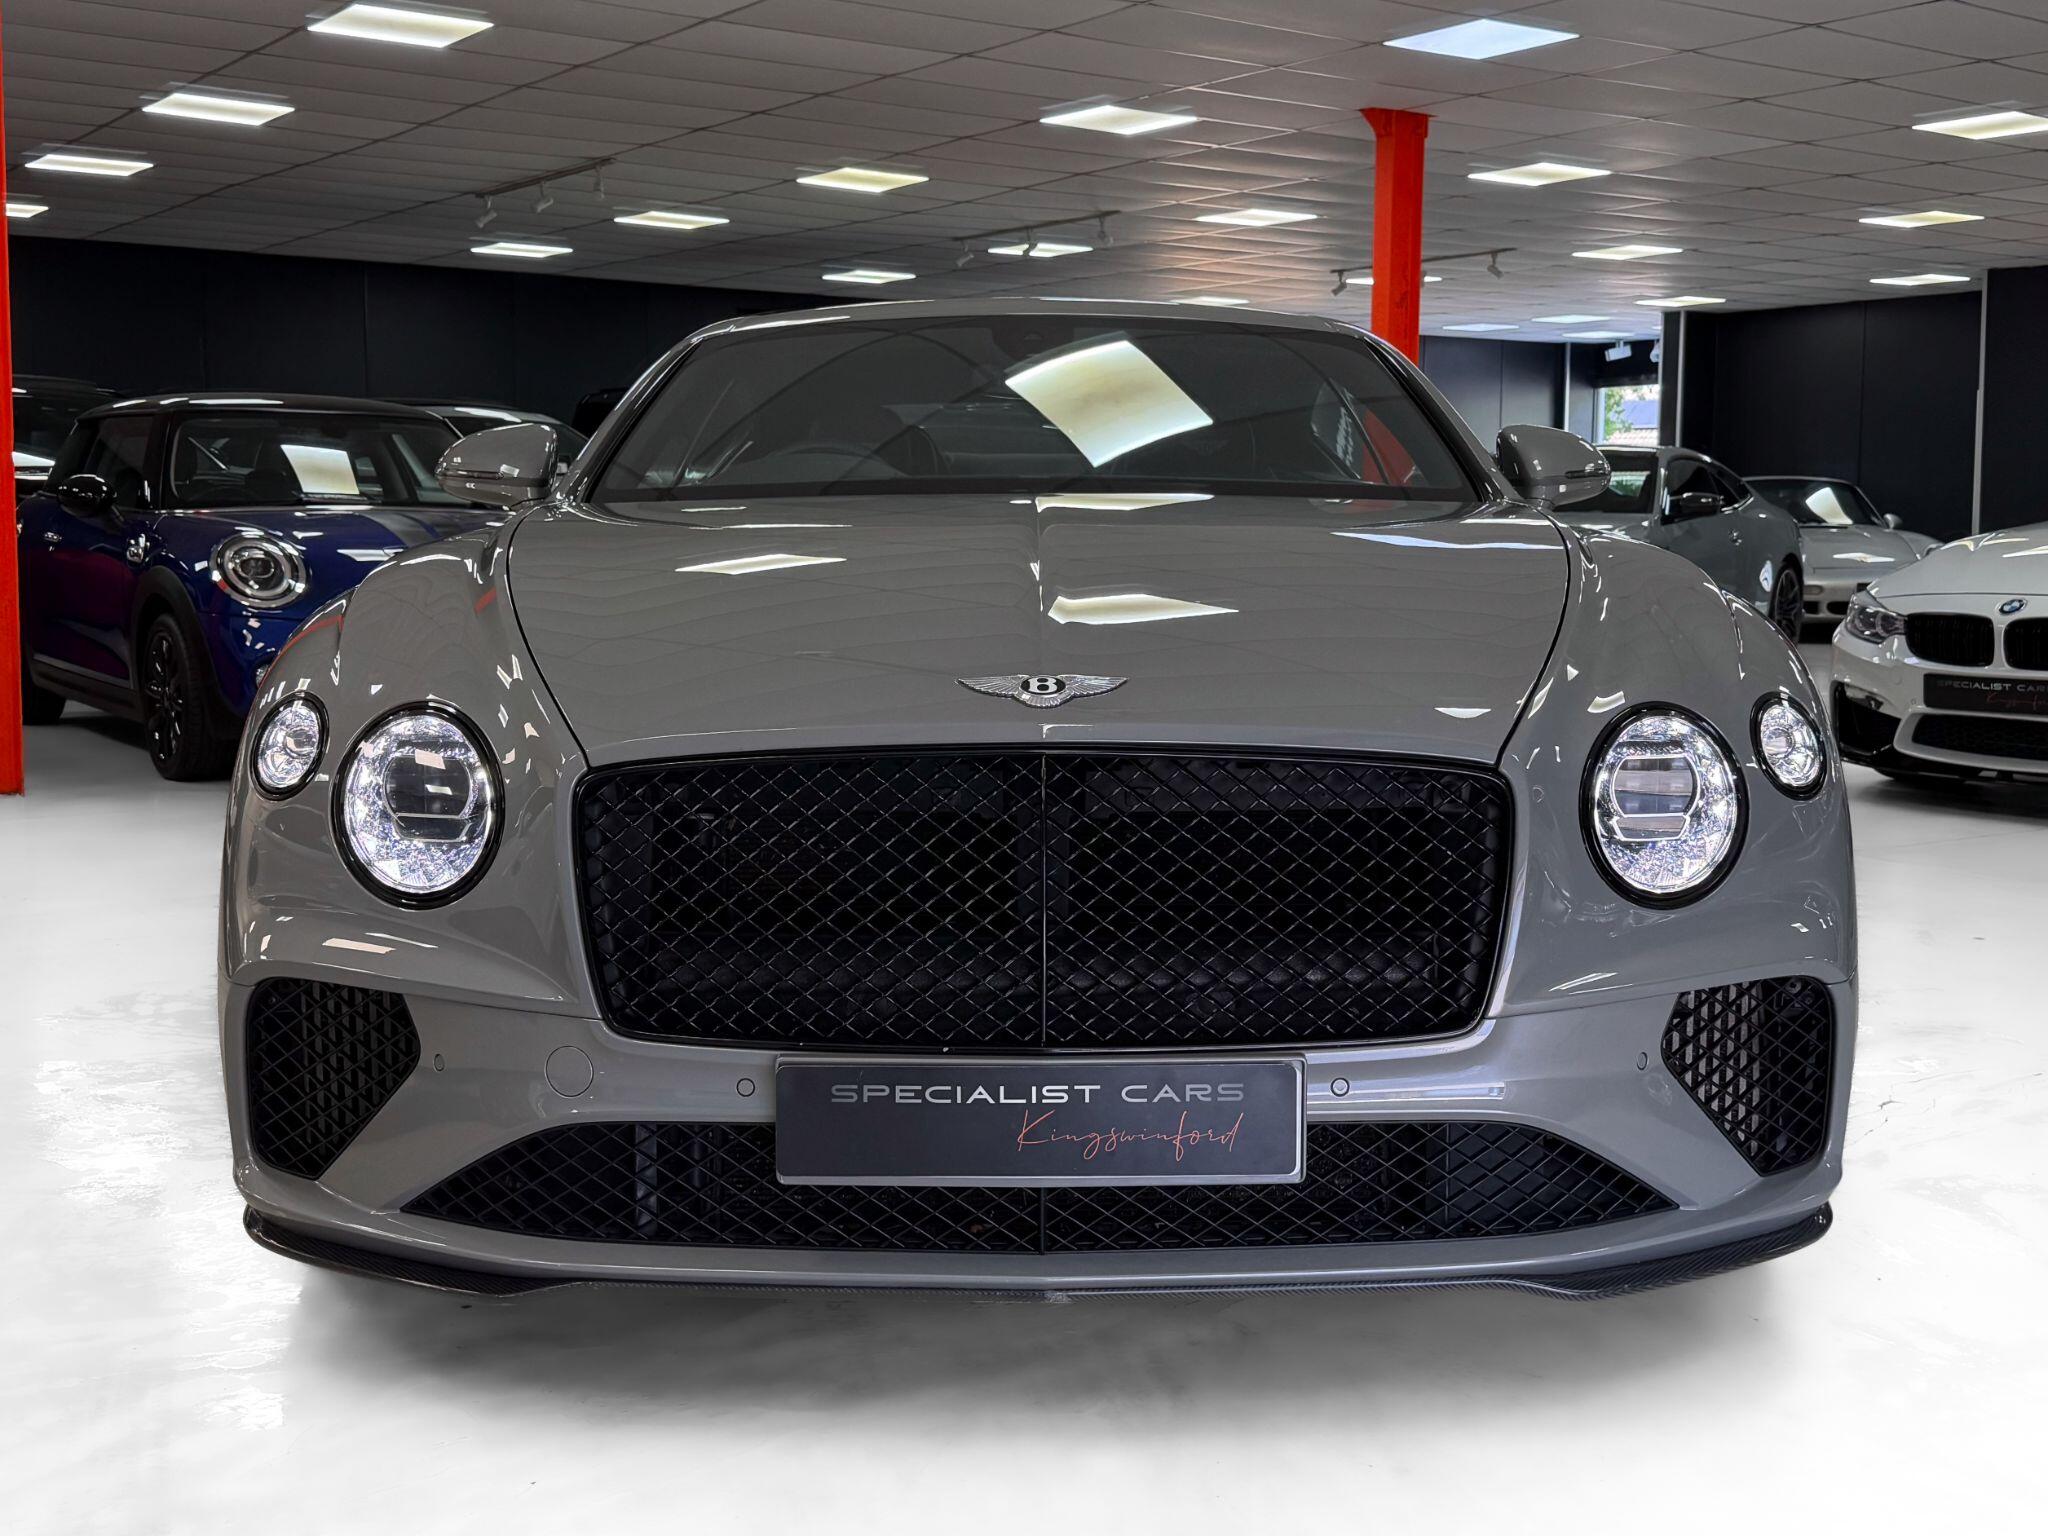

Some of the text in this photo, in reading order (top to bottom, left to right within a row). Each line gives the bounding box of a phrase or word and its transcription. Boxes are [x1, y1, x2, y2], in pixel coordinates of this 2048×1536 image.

[1028, 676, 1058, 694] B
[2016, 684, 2048, 693] CAR
[830, 1083, 1245, 1105] SPECIALIST CARS
[1016, 1108, 1245, 1161] Kingswinford
